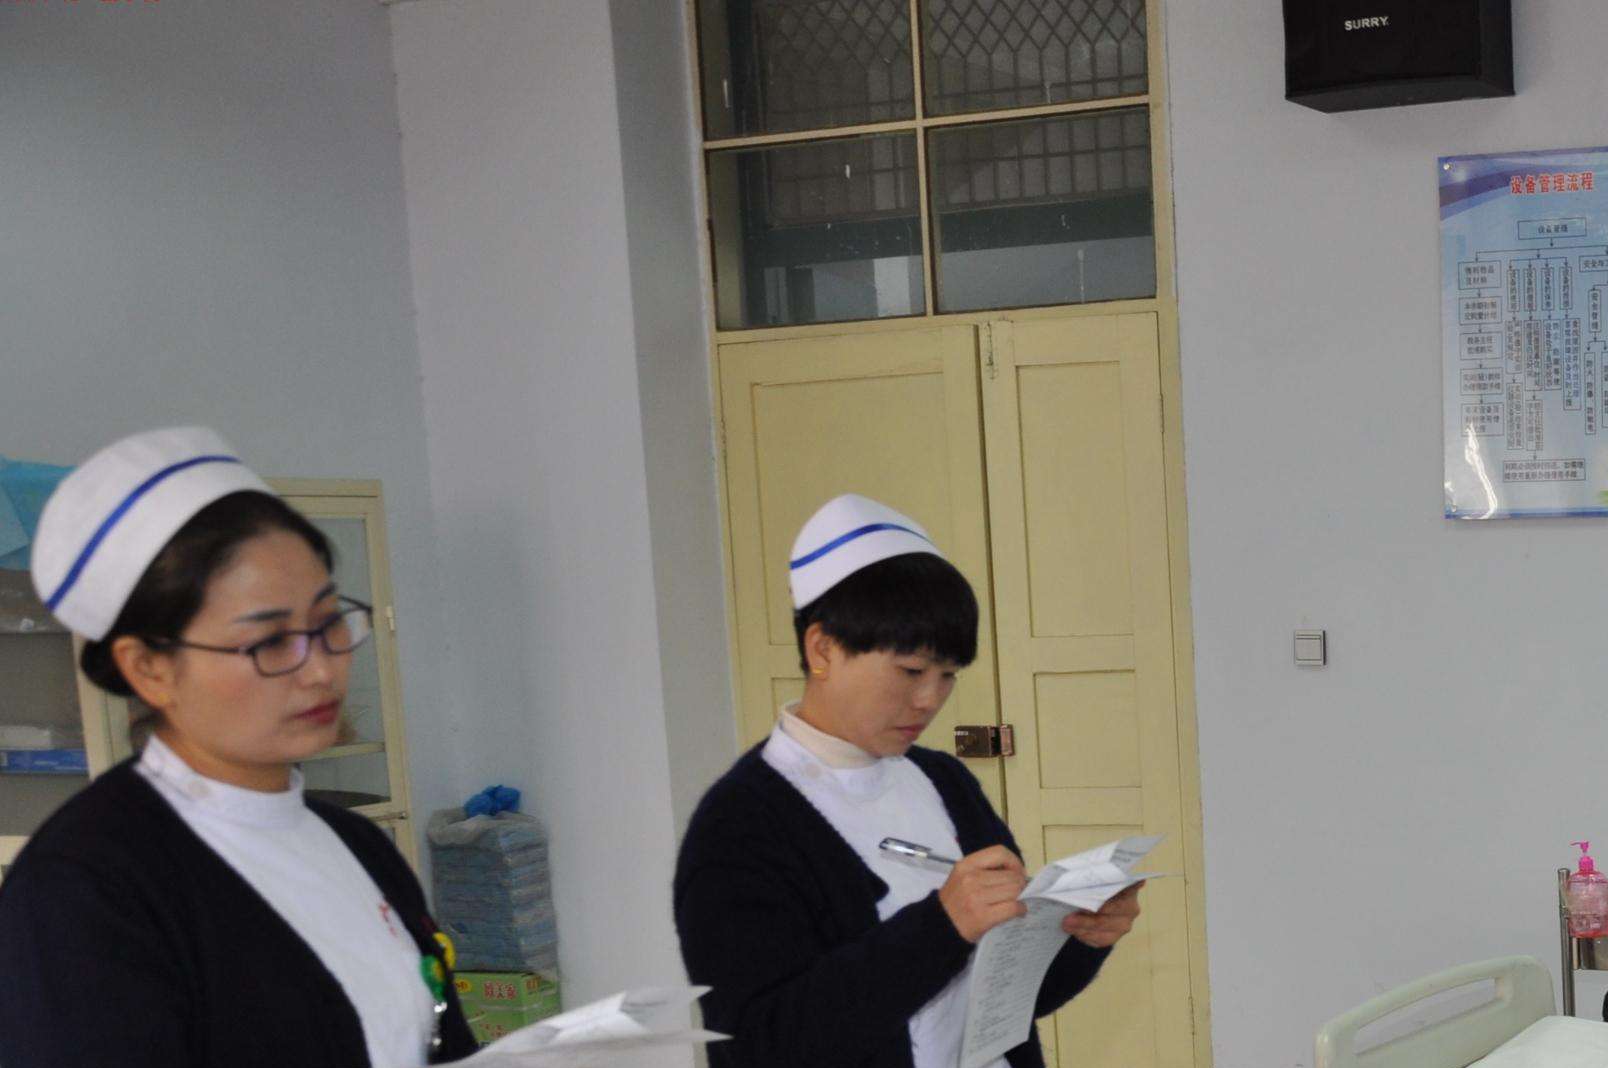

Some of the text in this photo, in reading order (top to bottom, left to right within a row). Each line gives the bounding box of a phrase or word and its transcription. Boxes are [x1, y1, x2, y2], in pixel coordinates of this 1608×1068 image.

[1344, 16, 1389, 31] SURRY
[1510, 171, 1594, 195] 设备管理流程
